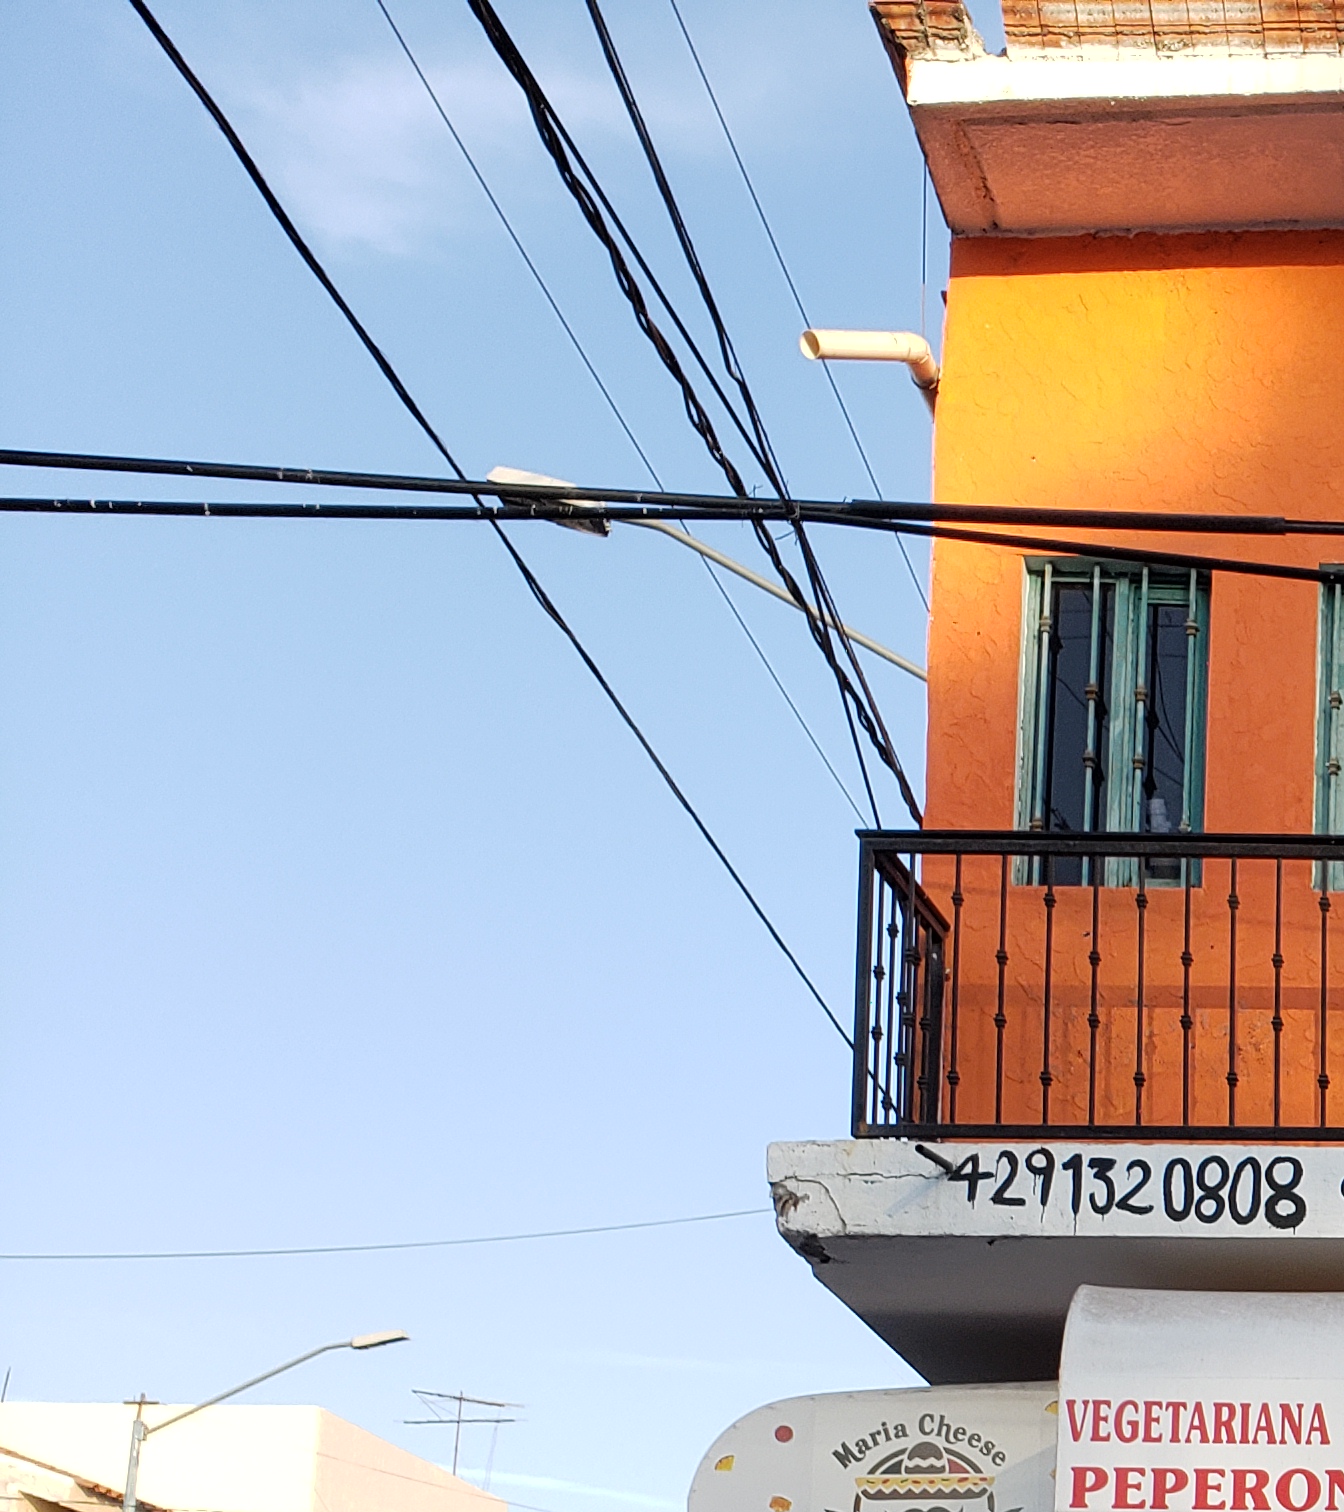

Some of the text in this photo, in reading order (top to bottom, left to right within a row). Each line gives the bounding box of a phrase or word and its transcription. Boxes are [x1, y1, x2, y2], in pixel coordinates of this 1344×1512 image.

[948, 1147, 1306, 1229] 4291320808
[832, 1413, 1007, 1470] Maria Cheese
[1066, 1399, 1330, 1445] VEGETARIANA
